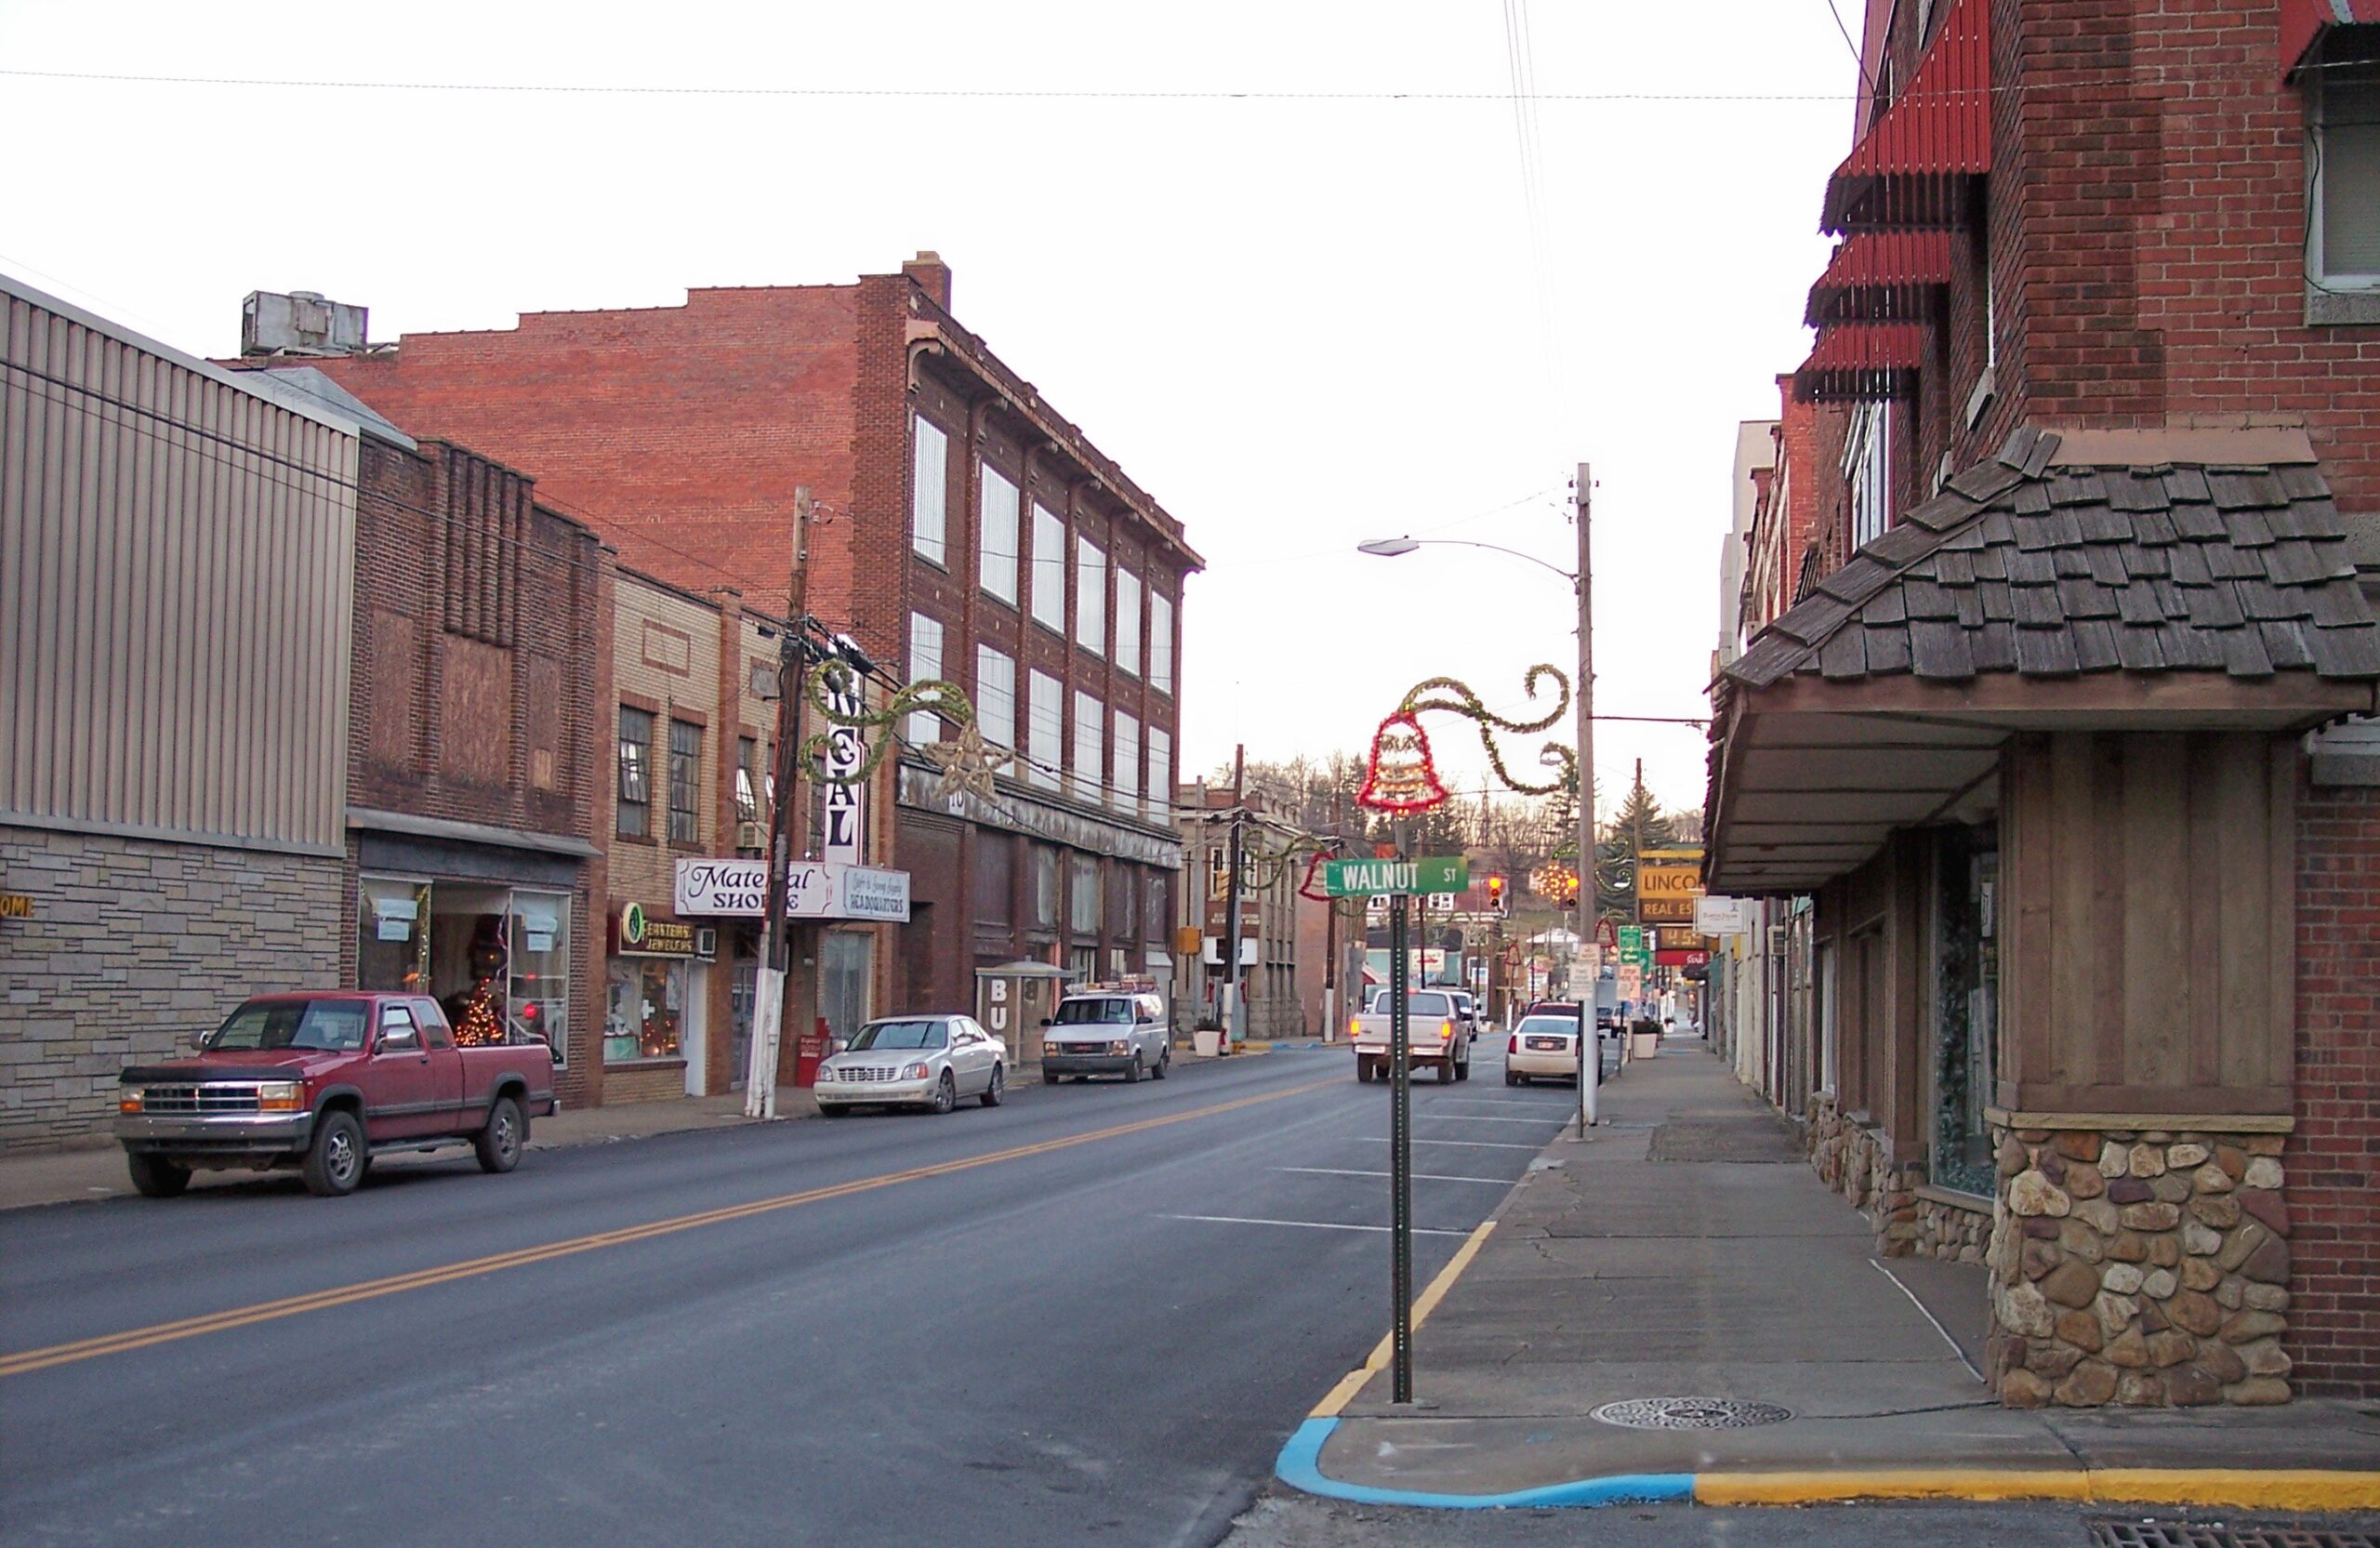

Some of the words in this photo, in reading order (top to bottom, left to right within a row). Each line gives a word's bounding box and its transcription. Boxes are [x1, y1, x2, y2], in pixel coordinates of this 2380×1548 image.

[688, 866, 815, 898] Mateal
[1342, 863, 1419, 891] WALNUT
[1443, 867, 1457, 882] ST
[712, 893, 799, 909] SHOE
[1644, 904, 1673, 915] REAL
